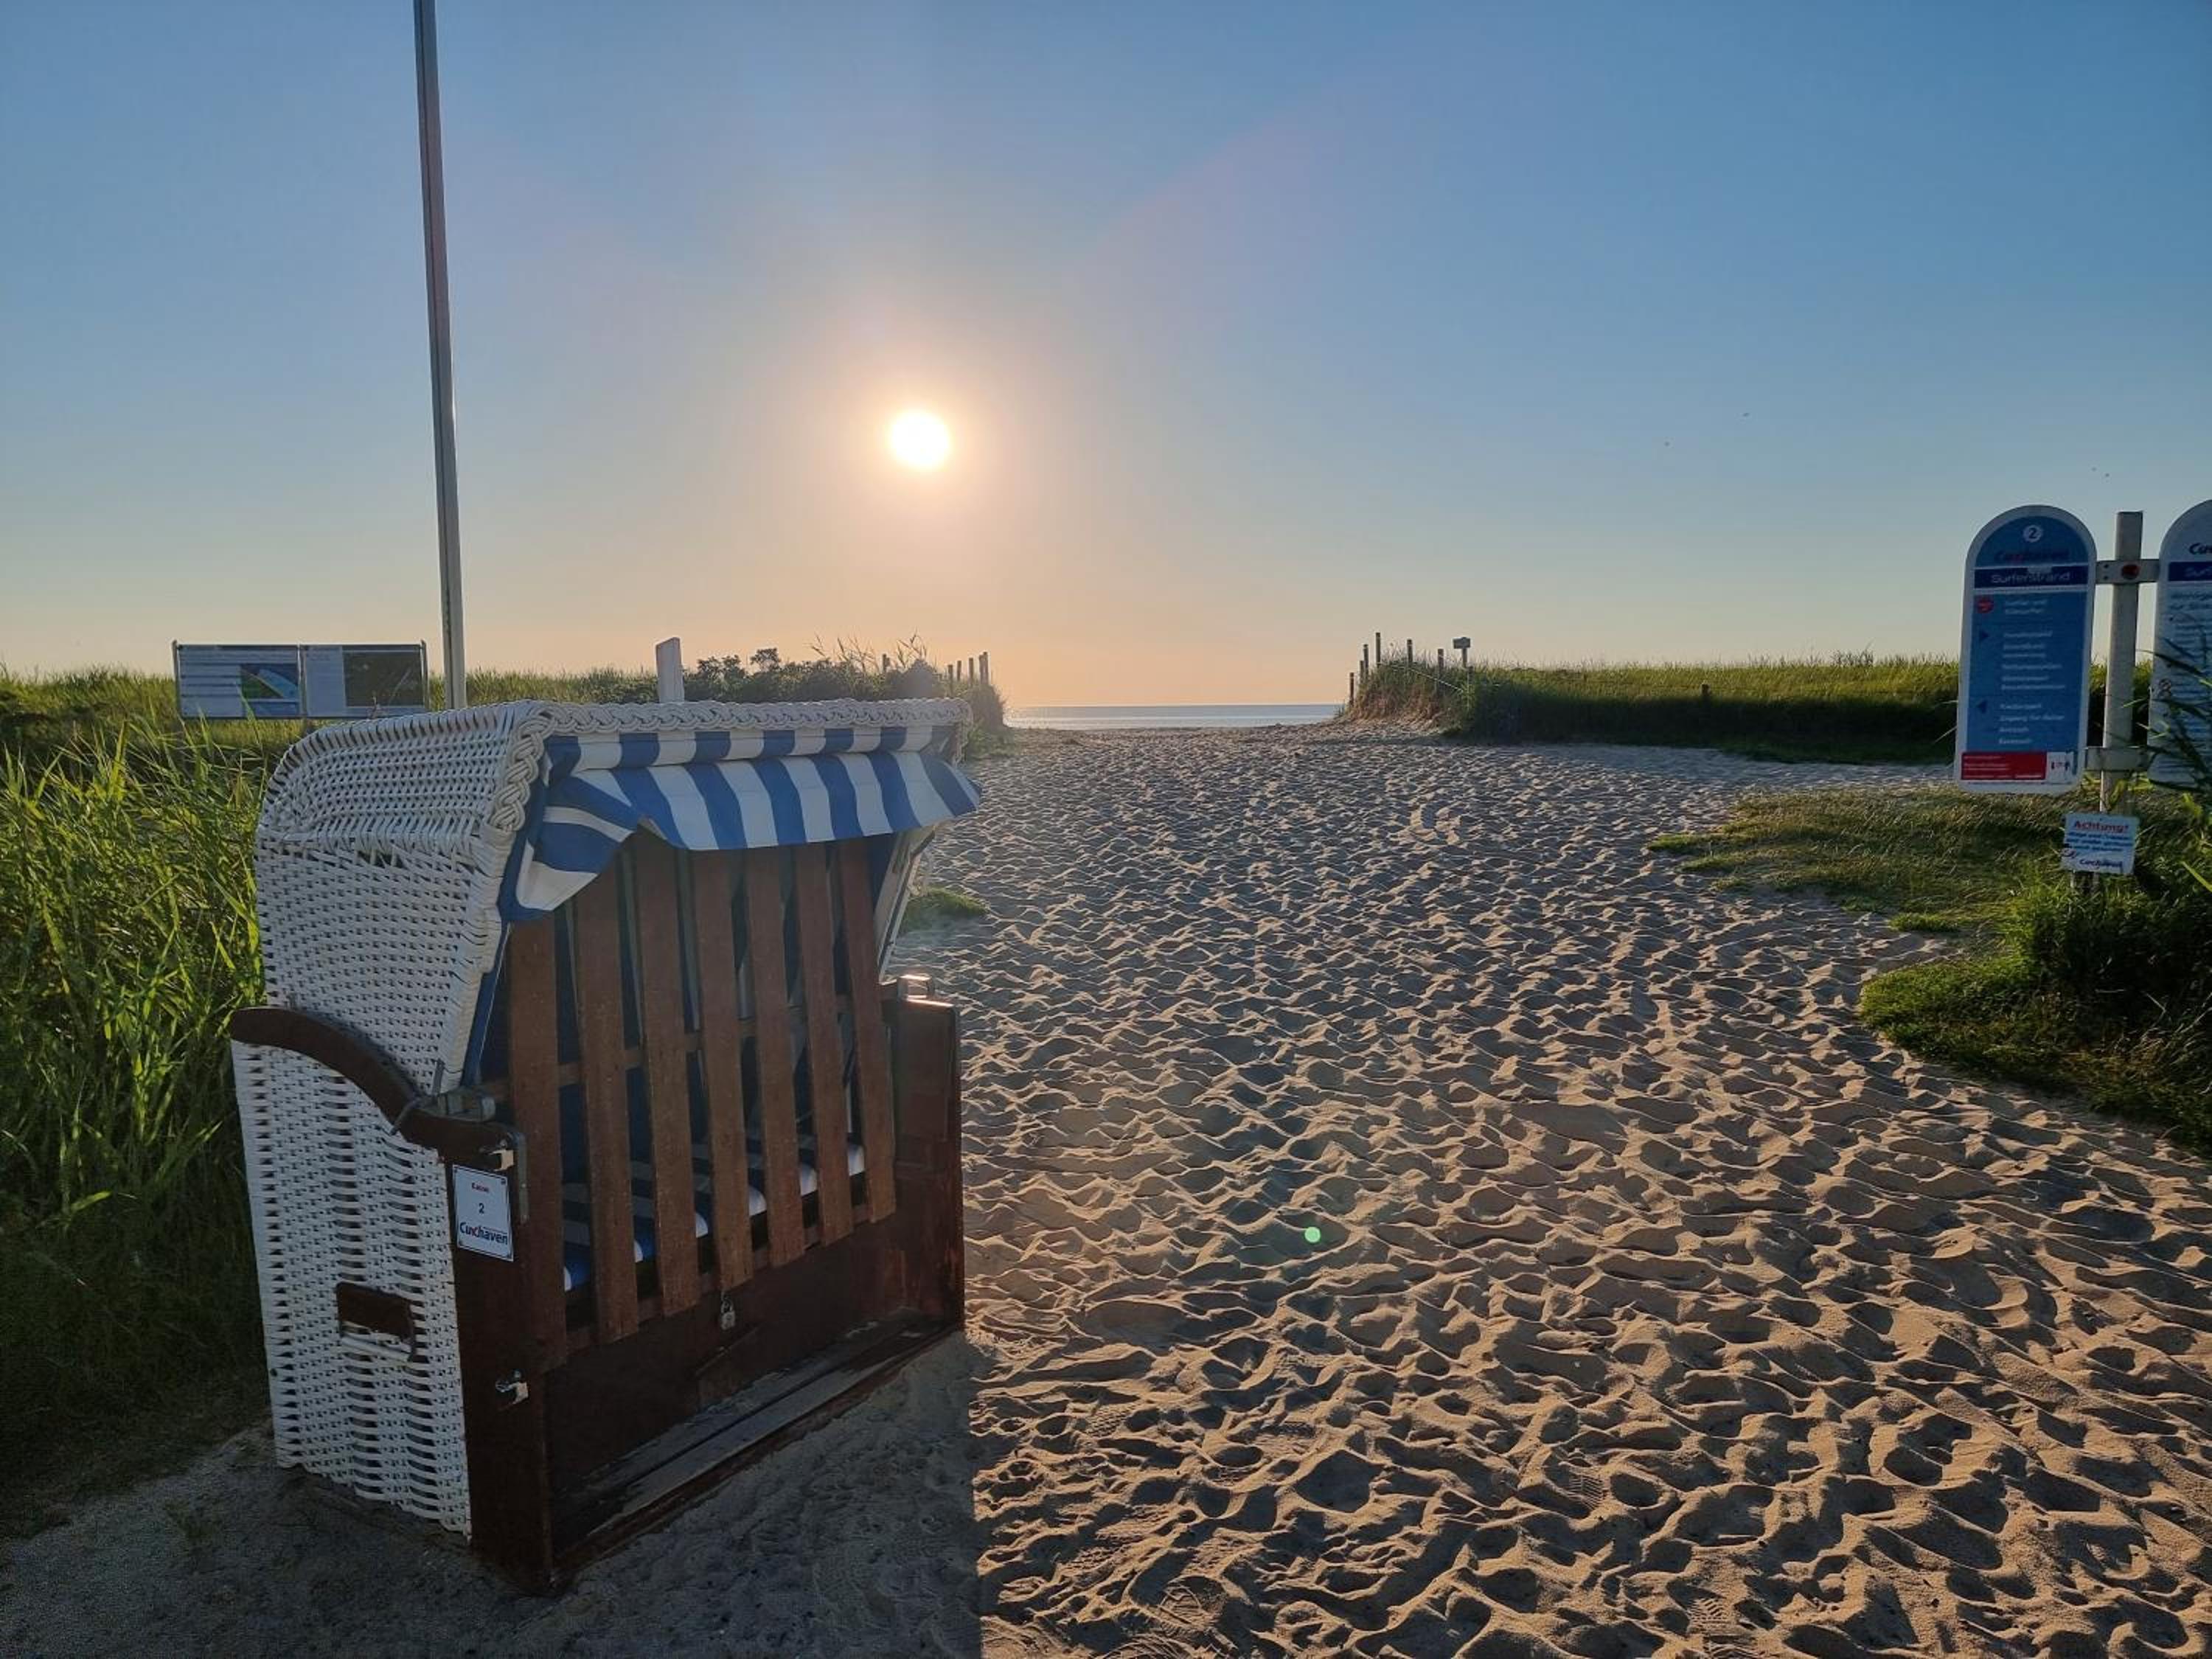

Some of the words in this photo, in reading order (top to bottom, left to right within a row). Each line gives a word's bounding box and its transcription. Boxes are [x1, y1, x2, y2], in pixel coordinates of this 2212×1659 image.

[2028, 526, 2037, 540] 2
[479, 1203, 484, 1214] 2
[459, 1222, 508, 1245] Cuxhaven
